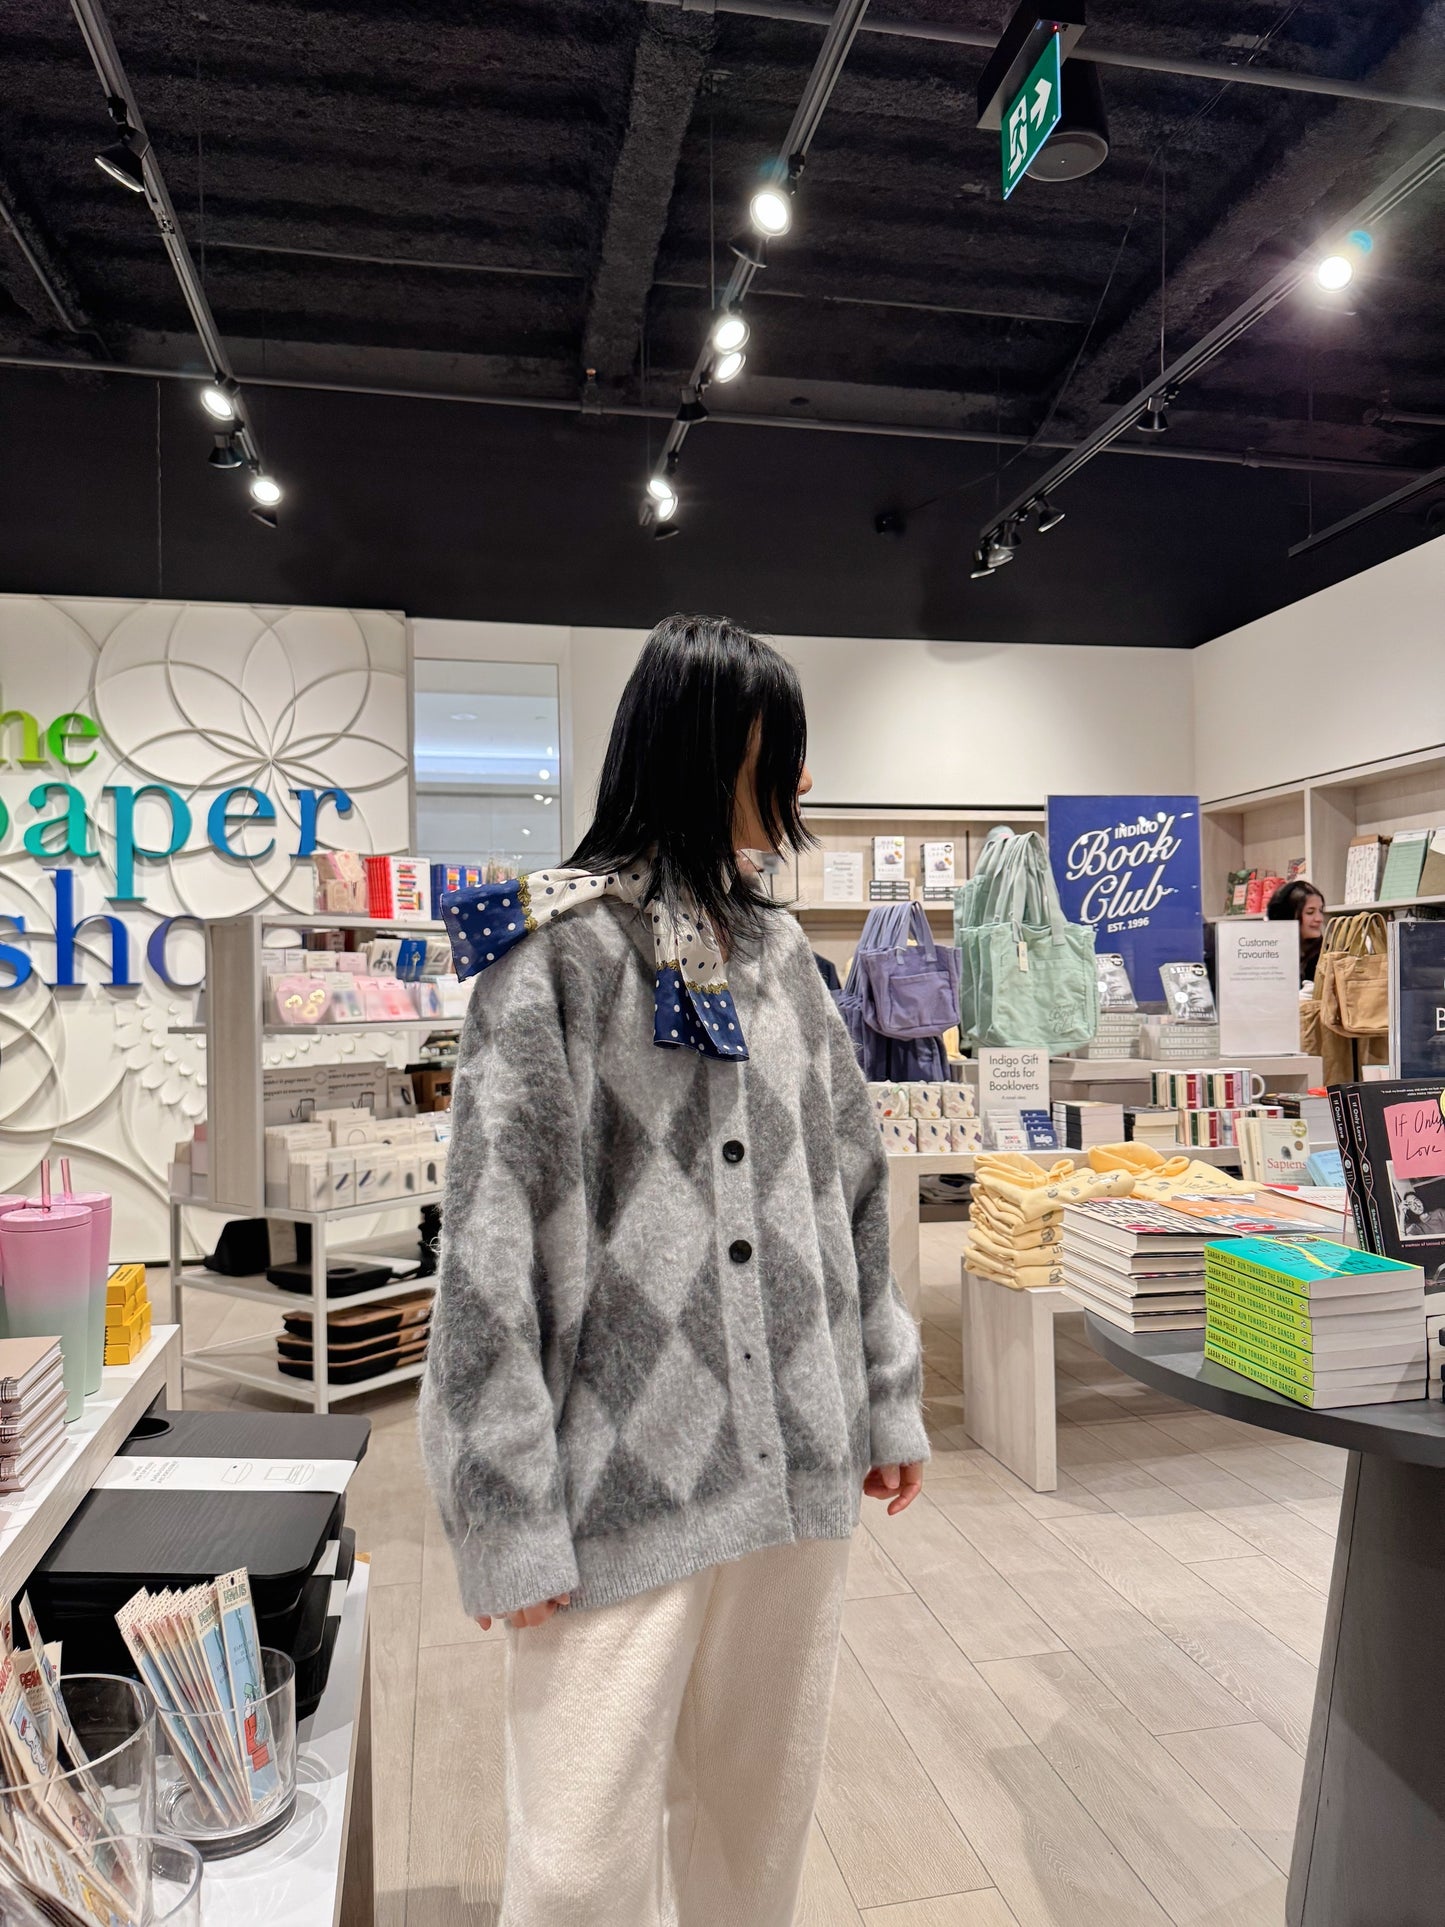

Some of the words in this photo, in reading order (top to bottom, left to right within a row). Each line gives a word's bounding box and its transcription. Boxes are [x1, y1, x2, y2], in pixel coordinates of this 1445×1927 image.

[0, 709, 100, 767] he
[0, 782, 352, 901] aper
[1065, 815, 1182, 881] Book
[1114, 821, 1159, 839] INDIGO
[1080, 864, 1176, 924] Club
[0, 869, 206, 989] sho
[1107, 921, 1126, 933] EST.
[1127, 917, 1150, 930] 1996
[1238, 936, 1278, 947] Customer
[1237, 949, 1280, 959] Favourites
[989, 1054, 1019, 1067] Indigo
[1021, 1053, 1039, 1065] Gift
[992, 1067, 1020, 1078] Cards
[1022, 1067, 1036, 1078] for
[989, 1080, 1040, 1091] Booklovers
[1395, 1113, 1408, 1137] If
[1414, 1109, 1443, 1134] Only
[1267, 1158, 1307, 1172] Sapiens
[1406, 1139, 1443, 1161] Love
[1208, 1250, 1220, 1260] SARAH
[1221, 1254, 1236, 1266] POLLEY
[1237, 1260, 1247, 1270] RUN
[1247, 1264, 1267, 1278] TOWARDS
[1268, 1272, 1276, 1282] THE
[1277, 1275, 1294, 1288] DANGER
[1208, 1266, 1221, 1276] SARAH
[1222, 1271, 1236, 1283] POLLEY
[1238, 1277, 1247, 1287] RUN
[1247, 1281, 1267, 1296] TOWARDS
[1267, 1289, 1275, 1299] THE
[1276, 1293, 1294, 1306] DANGER
[1207, 1282, 1220, 1292] SARAH
[1221, 1287, 1236, 1299] POLLEY
[1238, 1294, 1247, 1304] RUN
[1247, 1297, 1267, 1312] TOWARDS
[1268, 1306, 1276, 1316] THE
[1277, 1310, 1294, 1323] DANGER
[1208, 1298, 1220, 1309] SARAH
[1221, 1304, 1236, 1315] POLLEY
[1238, 1310, 1247, 1320] RUN
[1248, 1314, 1268, 1329] TOWARDS
[1278, 1327, 1295, 1341] DANGER
[1208, 1331, 1221, 1342] SARAH
[1222, 1337, 1237, 1349] POLLEY
[1239, 1345, 1248, 1355] RUN
[1248, 1349, 1269, 1364] TOWARDS
[1270, 1358, 1278, 1369] THE
[1279, 1363, 1296, 1377] DANGER
[1210, 1315, 1222, 1326] SARAH
[1223, 1321, 1238, 1333] POLLEY
[1240, 1328, 1249, 1338] RUN
[1249, 1332, 1269, 1347] TOWARDS
[1270, 1342, 1278, 1352] THE
[1279, 1346, 1296, 1360] DANGER
[1207, 1348, 1220, 1359] SARAH
[1222, 1354, 1237, 1367] POLLEY
[1239, 1362, 1248, 1372] RUN
[1248, 1367, 1269, 1383] TOWARDS
[1270, 1376, 1278, 1387] THE
[1279, 1381, 1296, 1396] DANGER
